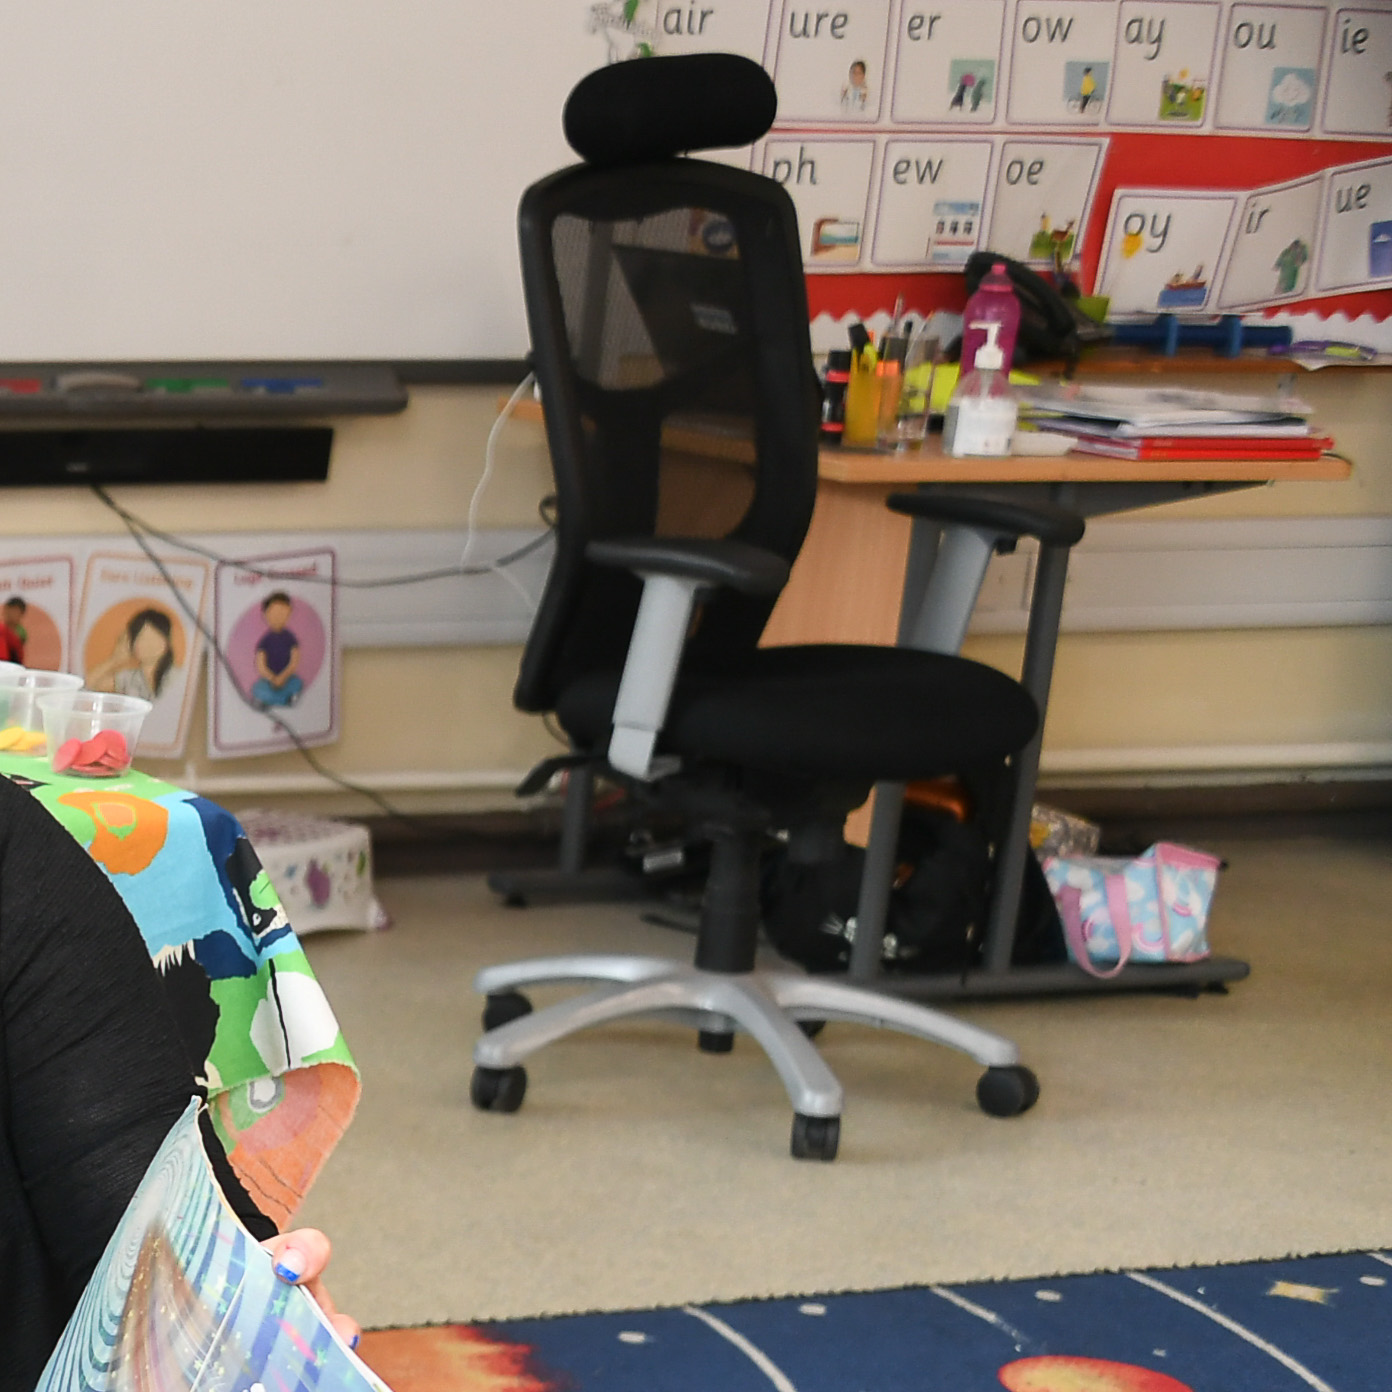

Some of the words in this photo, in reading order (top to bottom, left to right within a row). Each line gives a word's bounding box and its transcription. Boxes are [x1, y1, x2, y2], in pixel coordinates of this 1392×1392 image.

[662, 0, 714, 35] air
[789, 11, 848, 39] ure
[907, 12, 941, 42] er
[1021, 14, 1074, 43] ow
[1124, 14, 1166, 60] ay
[1233, 20, 1277, 50] ou
[1342, 22, 1370, 54] ie
[773, 145, 818, 186] ph
[892, 154, 944, 186] ew
[1005, 154, 1044, 186] oe
[1335, 178, 1372, 213] ue
[1123, 208, 1171, 252] oy
[1246, 202, 1272, 234] ir
